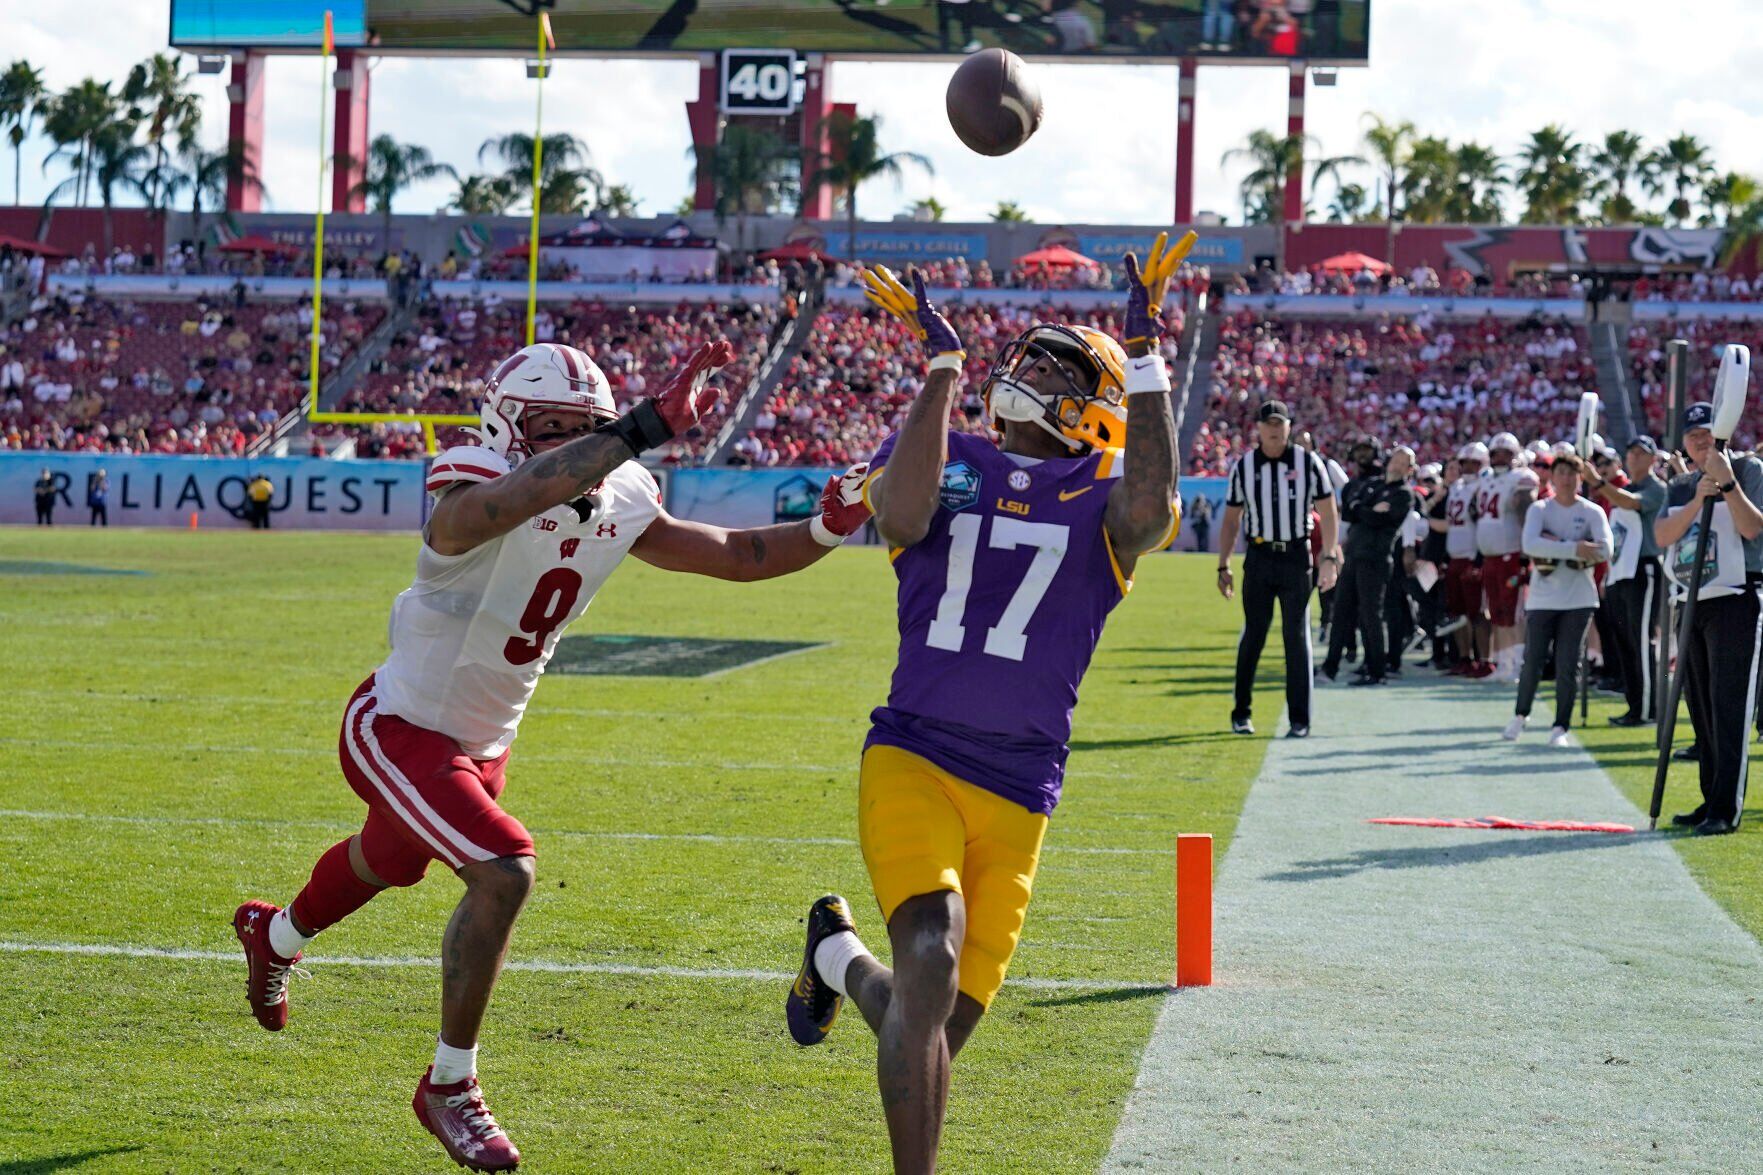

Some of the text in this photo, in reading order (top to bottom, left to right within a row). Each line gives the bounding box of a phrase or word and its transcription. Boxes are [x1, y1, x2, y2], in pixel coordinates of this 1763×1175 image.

[728, 63, 790, 101] 40
[996, 497, 1030, 516] LSU
[503, 566, 583, 666] 9
[925, 512, 1071, 662] 17
